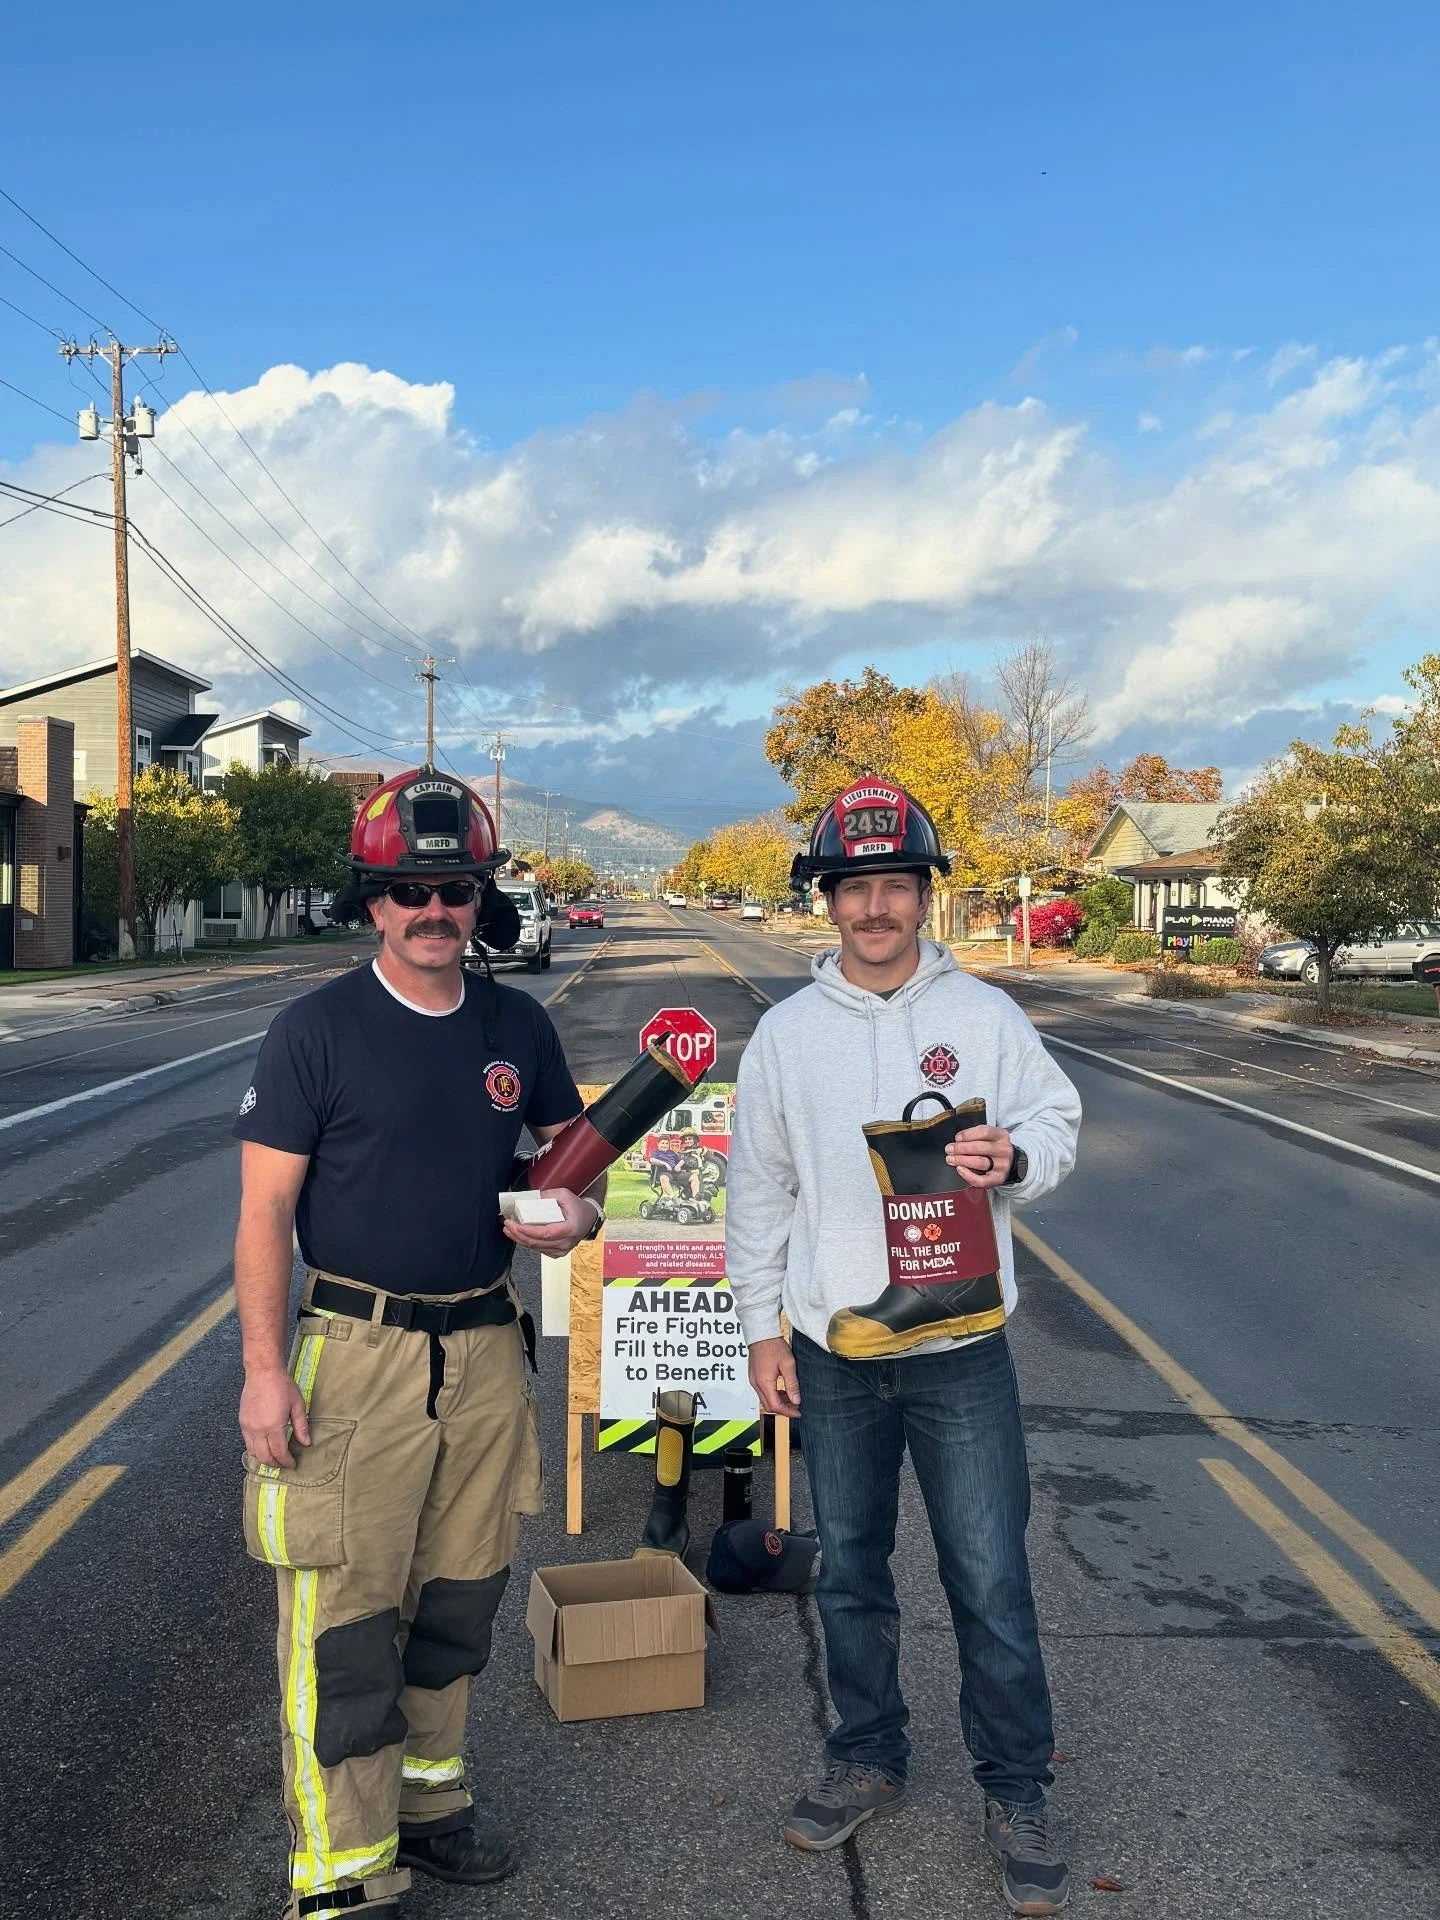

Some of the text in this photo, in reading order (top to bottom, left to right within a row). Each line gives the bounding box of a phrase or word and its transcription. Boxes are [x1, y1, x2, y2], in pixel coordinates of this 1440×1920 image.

[413, 782, 453, 793] CAPTAIN
[844, 789, 897, 805] LIEUTENANT
[843, 810, 899, 836] 2457
[425, 839, 451, 848] MRFD
[862, 843, 886, 853] MRFD
[1165, 916, 1234, 924] PLAY PIANO
[1167, 935, 1193, 948] Play!
[888, 1199, 956, 1221] DONATE
[618, 1243, 634, 1251] Give
[635, 1243, 665, 1253] strength
[675, 1243, 690, 1251] kids
[691, 1243, 704, 1251] and
[705, 1243, 726, 1251] adults
[890, 1241, 961, 1258] FILL THE BOOT
[645, 1260, 717, 1268] and related diseases.
[671, 1252, 707, 1261] dystrophy,
[900, 1256, 955, 1271] FOR MDA
[627, 1290, 734, 1314] AHEAD
[616, 1316, 659, 1335] Fire
[614, 1339, 748, 1358] Fill the Boot
[625, 1362, 736, 1381] to Benefit
